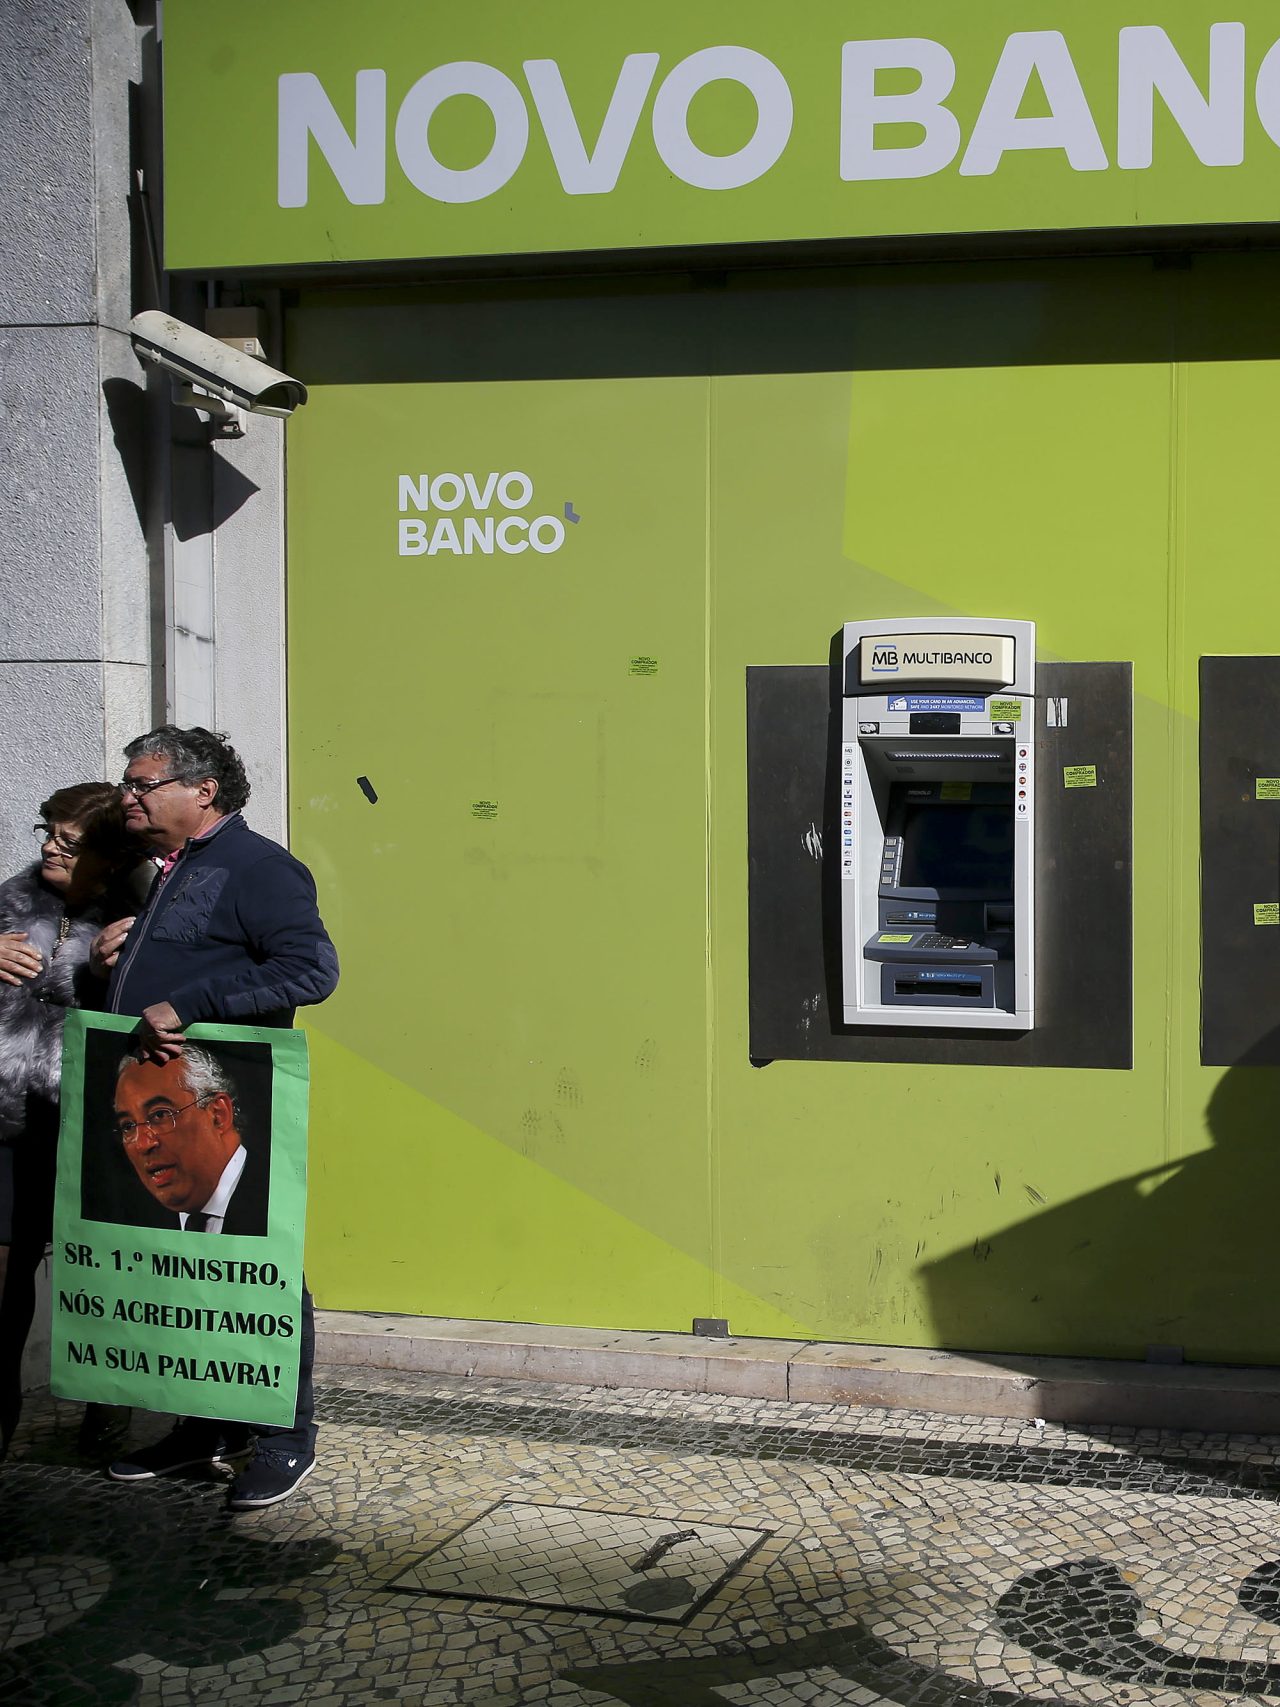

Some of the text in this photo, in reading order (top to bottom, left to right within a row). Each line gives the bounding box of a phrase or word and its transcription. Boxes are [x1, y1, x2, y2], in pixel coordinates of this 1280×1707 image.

[278, 45, 793, 208] NOVO
[398, 471, 534, 512] NOVO
[398, 515, 565, 555] BANCO
[872, 651, 993, 666] MB MULTIBANCO
[64, 1242, 100, 1268] SR.
[152, 1253, 287, 1290] MINISTRO,
[59, 1289, 294, 1338] NÓS ACREDITAMOS
[67, 1341, 281, 1389] NA SUA PALAVRA!
